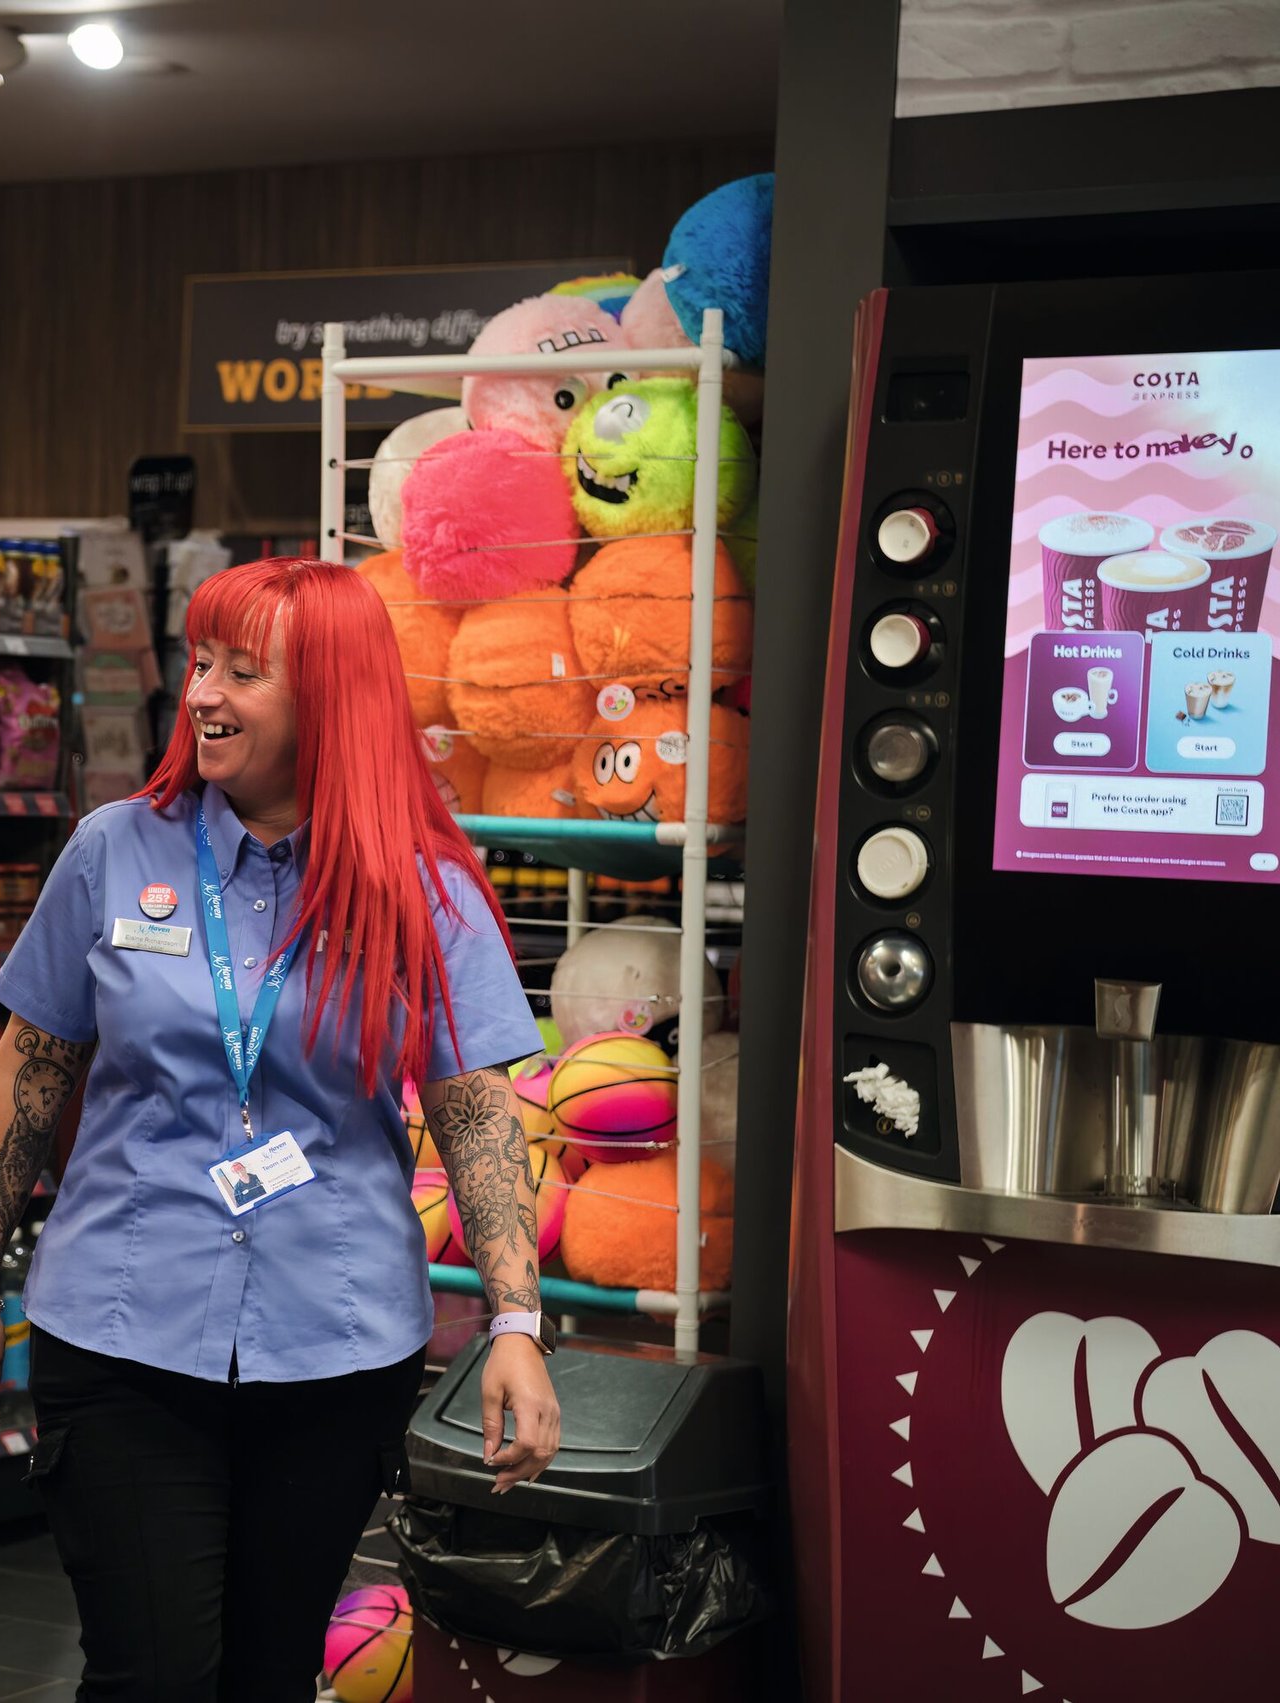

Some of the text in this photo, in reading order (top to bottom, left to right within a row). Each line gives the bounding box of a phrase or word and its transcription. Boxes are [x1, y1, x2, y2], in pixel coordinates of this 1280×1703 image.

[275, 318, 308, 351] try
[310, 311, 429, 348] smething
[1133, 371, 1200, 387] COSTA
[1141, 391, 1200, 400] EXPRESS
[1047, 440, 1107, 459] Here
[1114, 441, 1140, 459] to
[1053, 645, 1123, 659] Hot Drinks
[1173, 647, 1250, 660] Cold Drinks
[1071, 740, 1093, 749] Start
[1195, 743, 1218, 753] Start
[1091, 792, 1187, 806] Prefer to order using
[1103, 805, 1120, 814] the
[1120, 806, 1149, 815] Costa
[147, 894, 170, 903] 25?
[213, 894, 222, 919] Haven
[148, 924, 170, 934] Haven
[269, 953, 286, 977] Haven
[222, 966, 233, 990] Haven
[246, 1026, 259, 1054] Haven
[233, 1042, 243, 1070] Haven
[269, 1142, 287, 1153] Haven
[262, 1161, 279, 1171] Team
